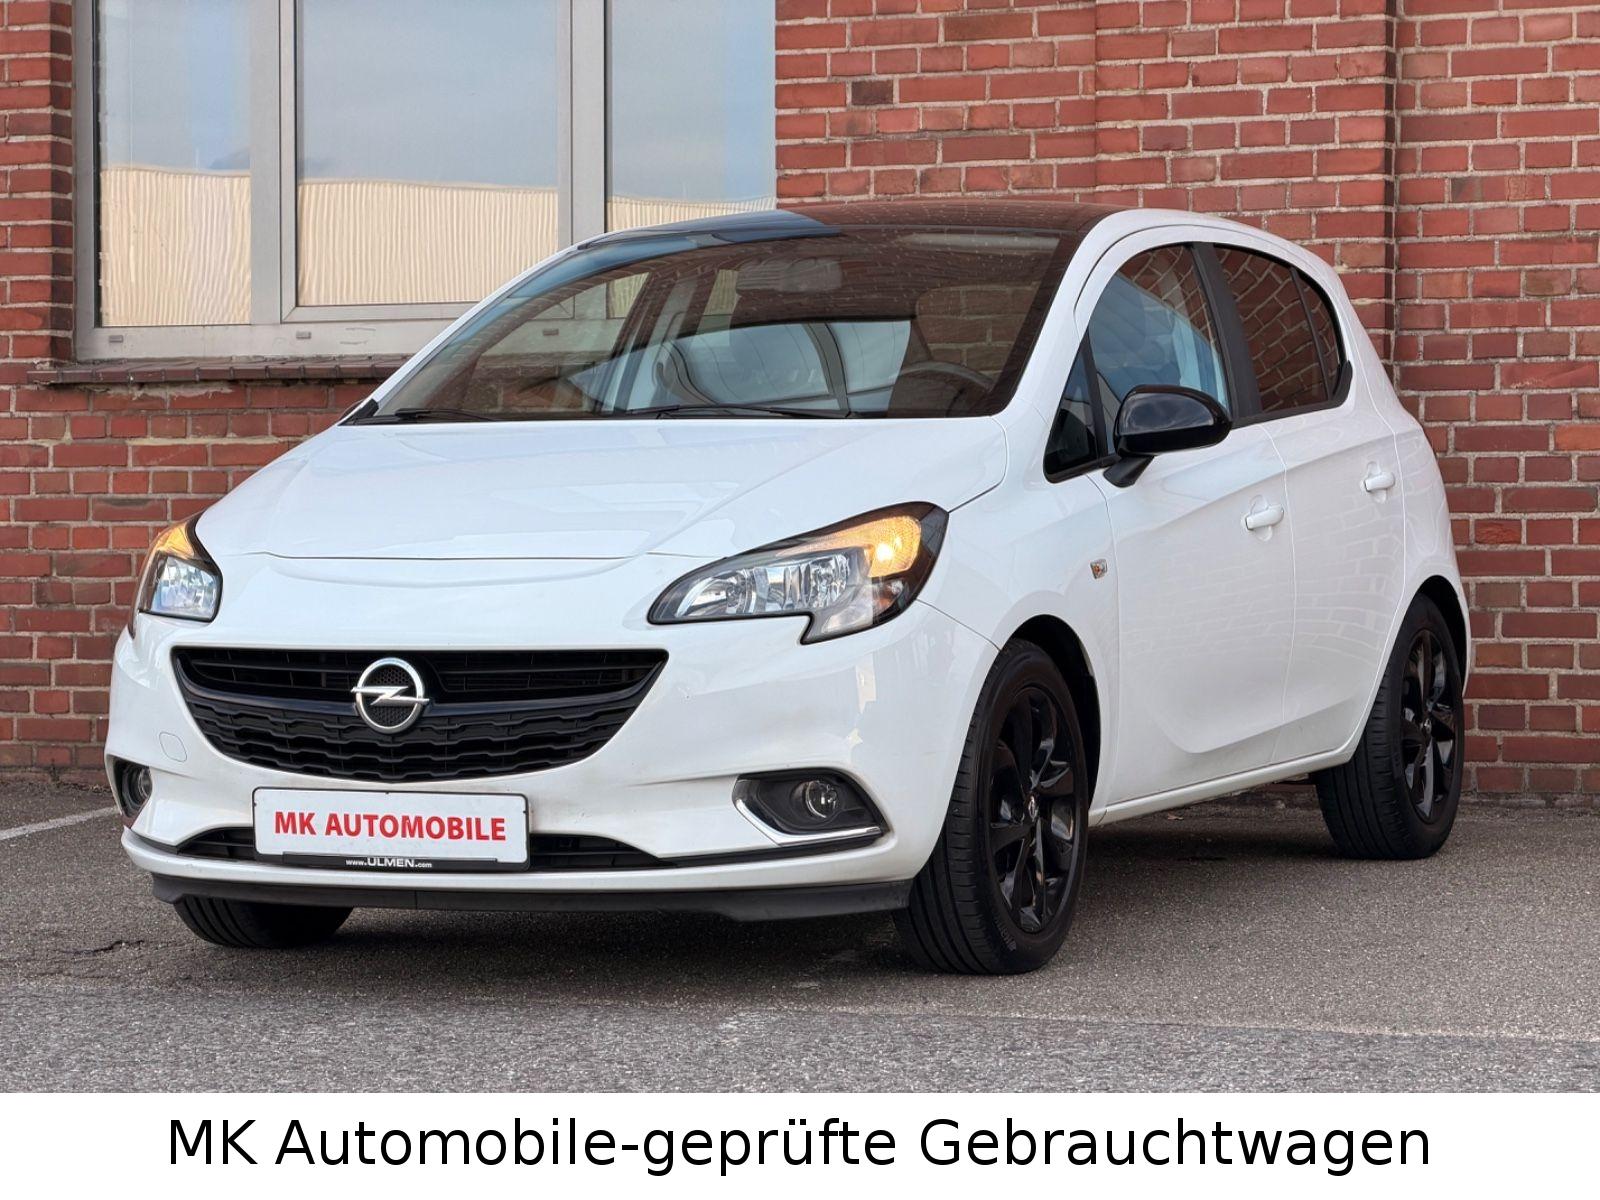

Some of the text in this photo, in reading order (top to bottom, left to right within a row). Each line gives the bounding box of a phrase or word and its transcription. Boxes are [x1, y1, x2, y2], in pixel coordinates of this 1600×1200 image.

[274, 811, 506, 841] MK AUTOMOBILE
[345, 857, 433, 868] www.ULMEN.com
